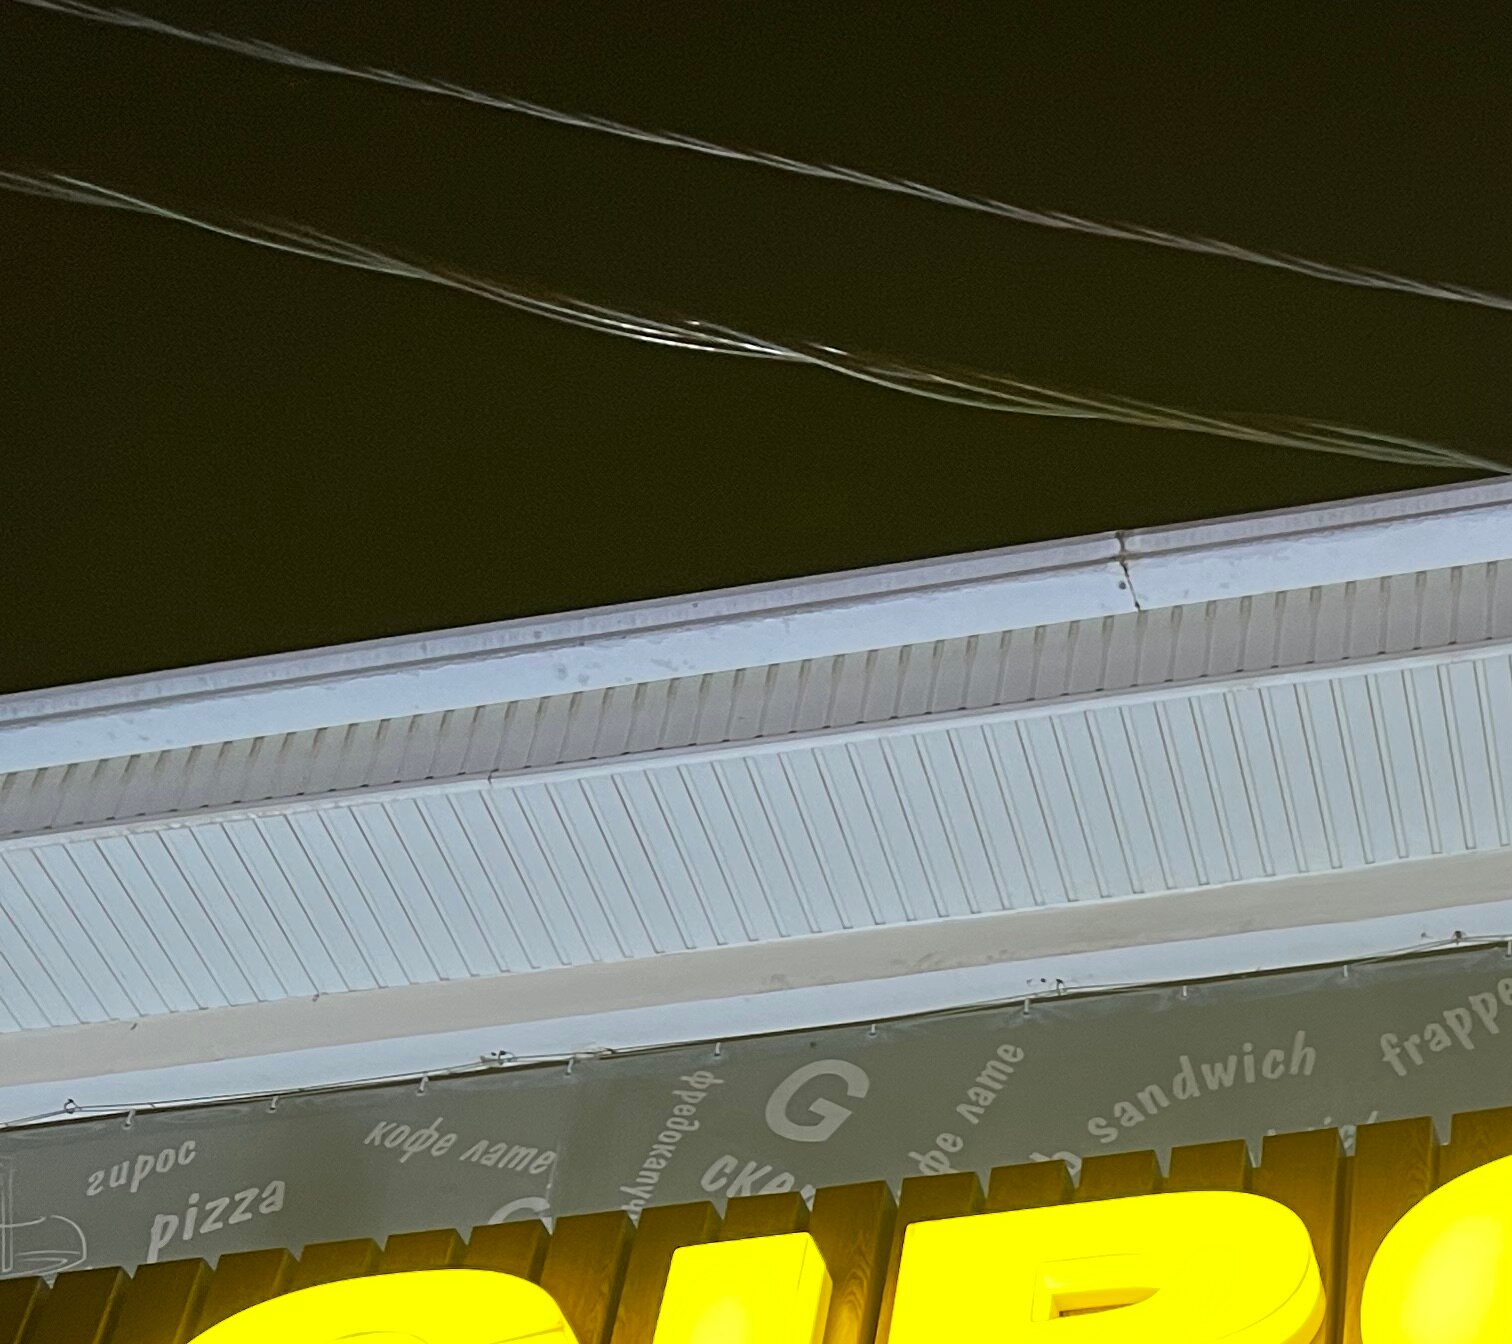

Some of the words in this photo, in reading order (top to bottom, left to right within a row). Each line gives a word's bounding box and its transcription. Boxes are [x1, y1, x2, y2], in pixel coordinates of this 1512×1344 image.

[765, 1058, 871, 1142] G
[1087, 1030, 1317, 1143] sandwich
[363, 1116, 458, 1163] кофе
[146, 1180, 286, 1264] pizza
